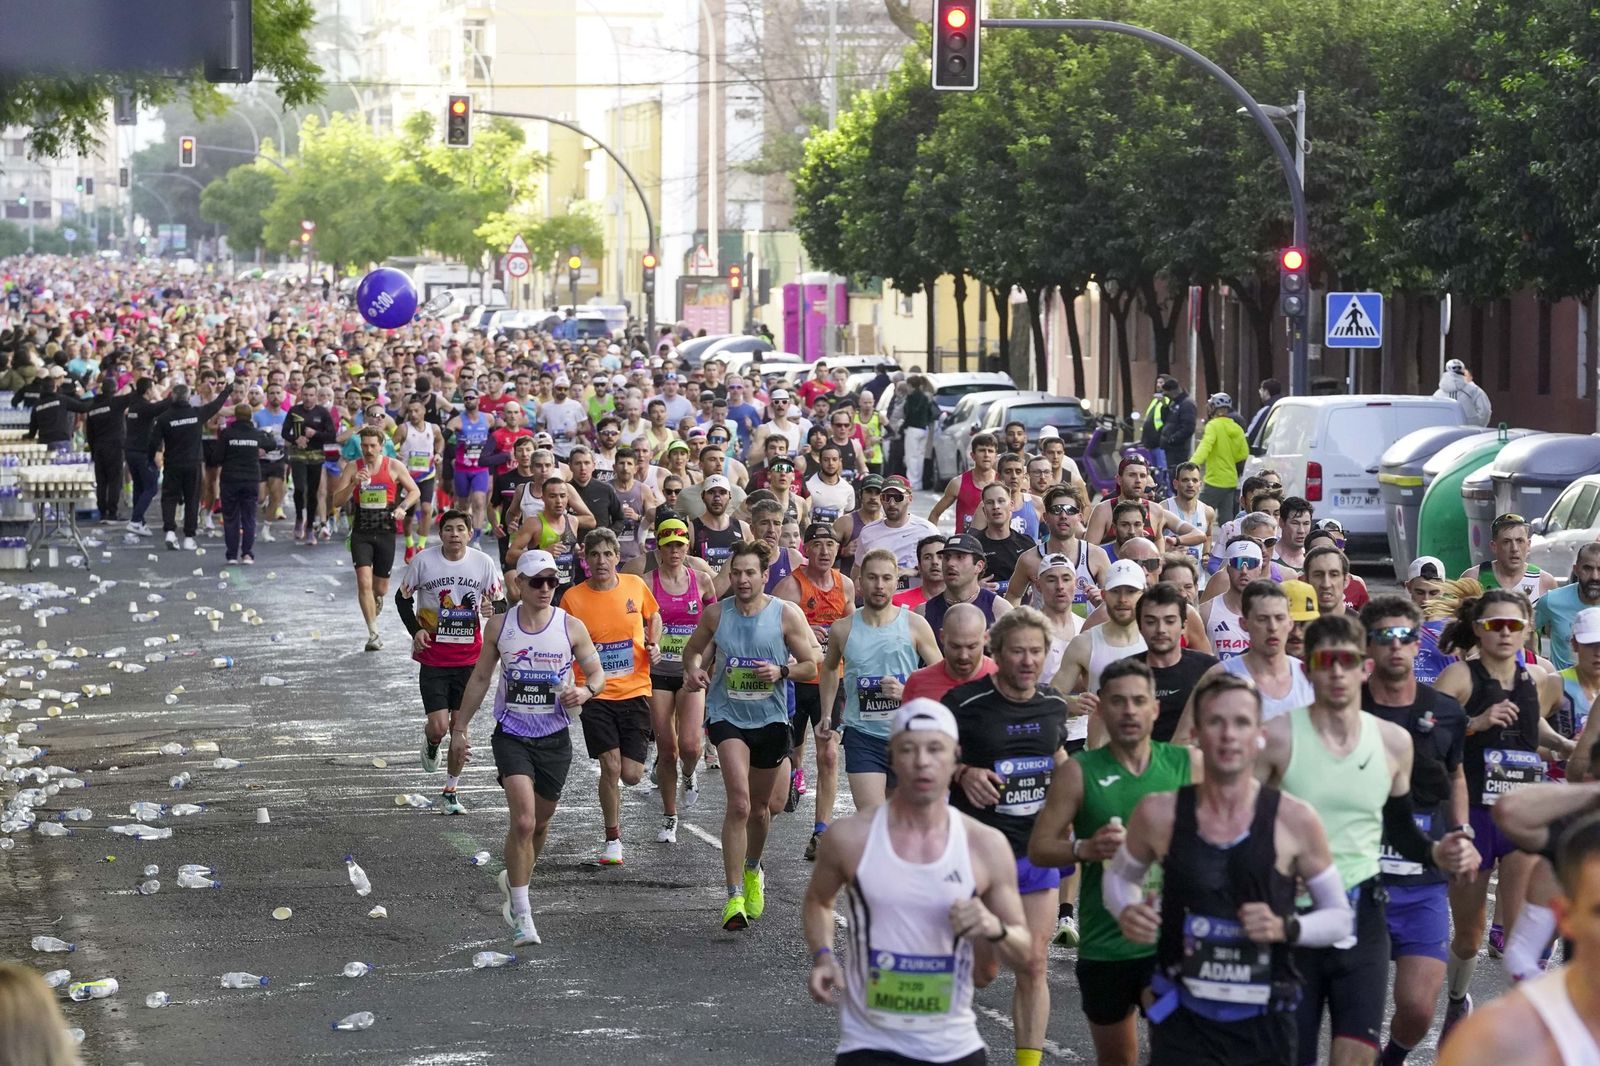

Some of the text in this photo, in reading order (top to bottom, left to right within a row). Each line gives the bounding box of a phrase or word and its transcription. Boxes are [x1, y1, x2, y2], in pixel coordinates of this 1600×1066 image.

[511, 261, 526, 270] 30
[371, 291, 394, 314] 3:00
[169, 416, 199, 427] VOLUNTEER
[228, 439, 259, 447] VOLUNTEER
[1339, 496, 1362, 505] 9177
[438, 627, 474, 636] M.LUCERO
[606, 642, 629, 650] ZURICH
[533, 651, 563, 660] Fenland
[601, 659, 630, 670] ESITAR
[523, 672, 551, 680] ZURICH
[523, 685, 539, 693] 4056
[740, 680, 769, 690] ANGEL
[515, 693, 547, 704] AARON
[1506, 752, 1537, 763] ZURICH
[1016, 760, 1049, 771] ZURICH
[1018, 777, 1036, 787] 4133
[1006, 787, 1046, 804] CARLOS
[899, 958, 947, 970] ZURICH
[1198, 960, 1252, 983] ADAM
[875, 992, 942, 1012] MICHAEL
